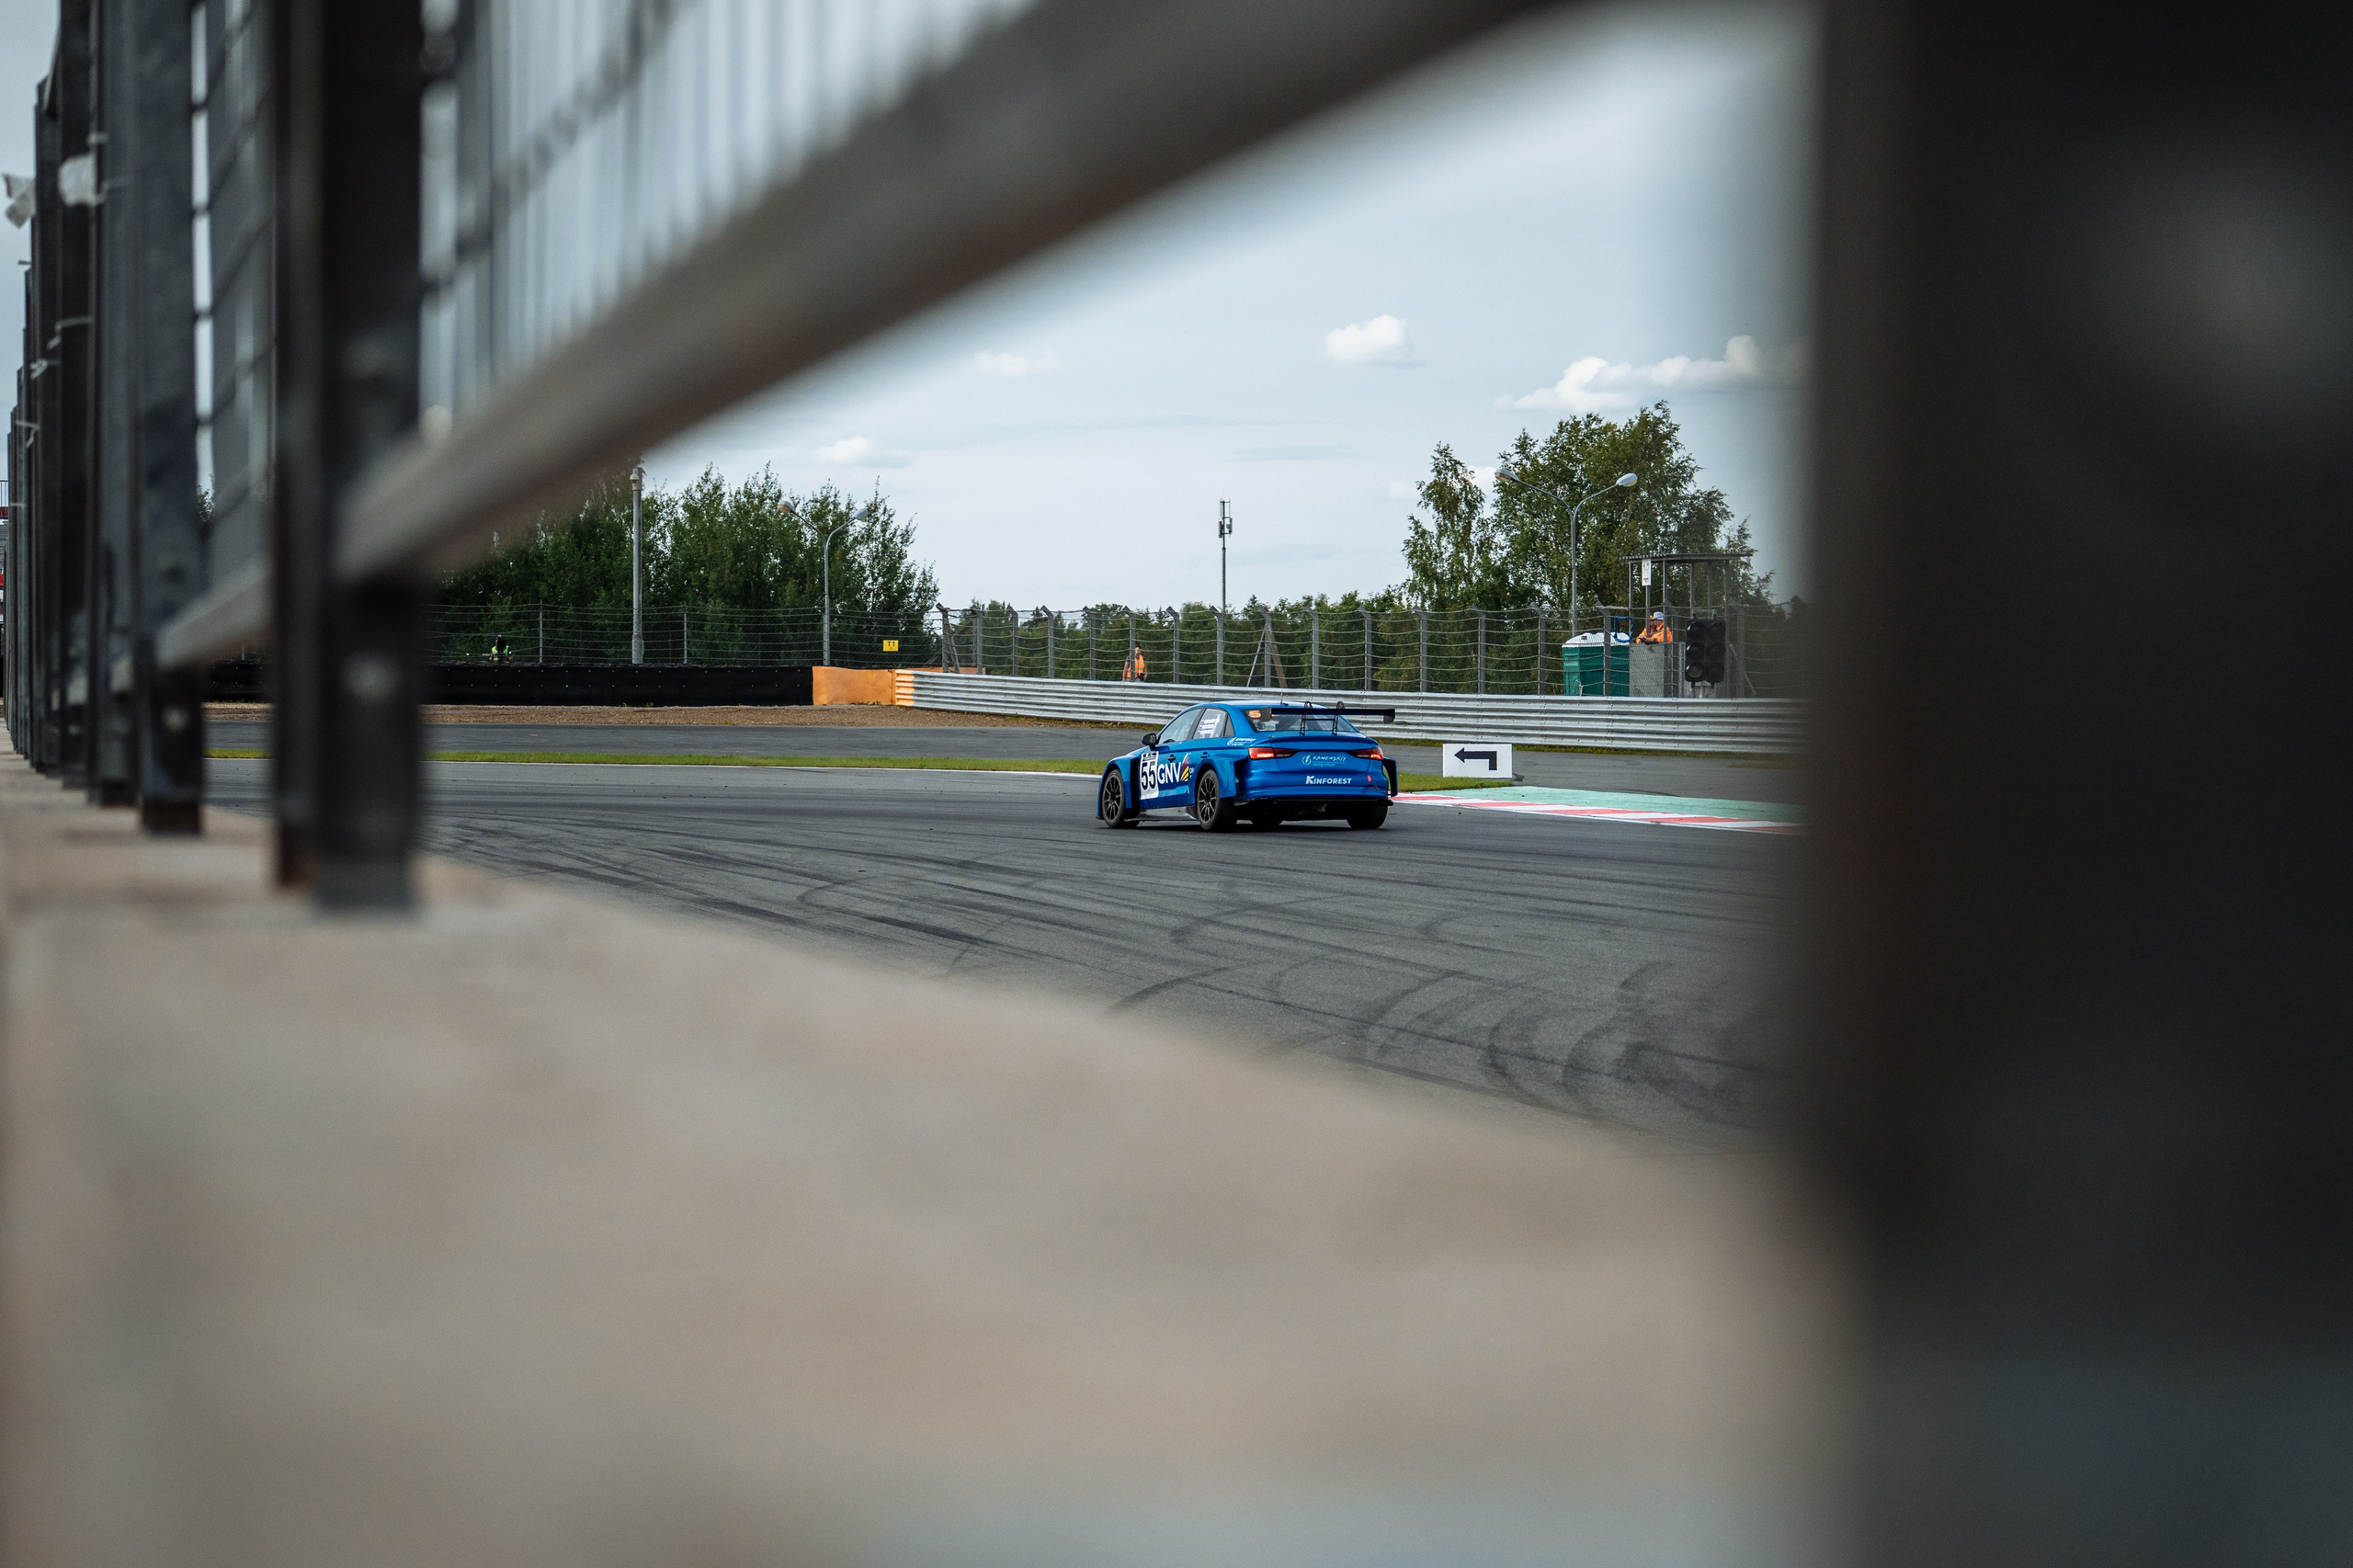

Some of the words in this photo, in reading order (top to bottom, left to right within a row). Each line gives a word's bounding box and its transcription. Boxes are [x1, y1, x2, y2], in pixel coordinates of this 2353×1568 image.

[1142, 761, 1156, 790] 55
[1158, 762, 1182, 785] GNV
[1305, 776, 1352, 784] KINFOREST
